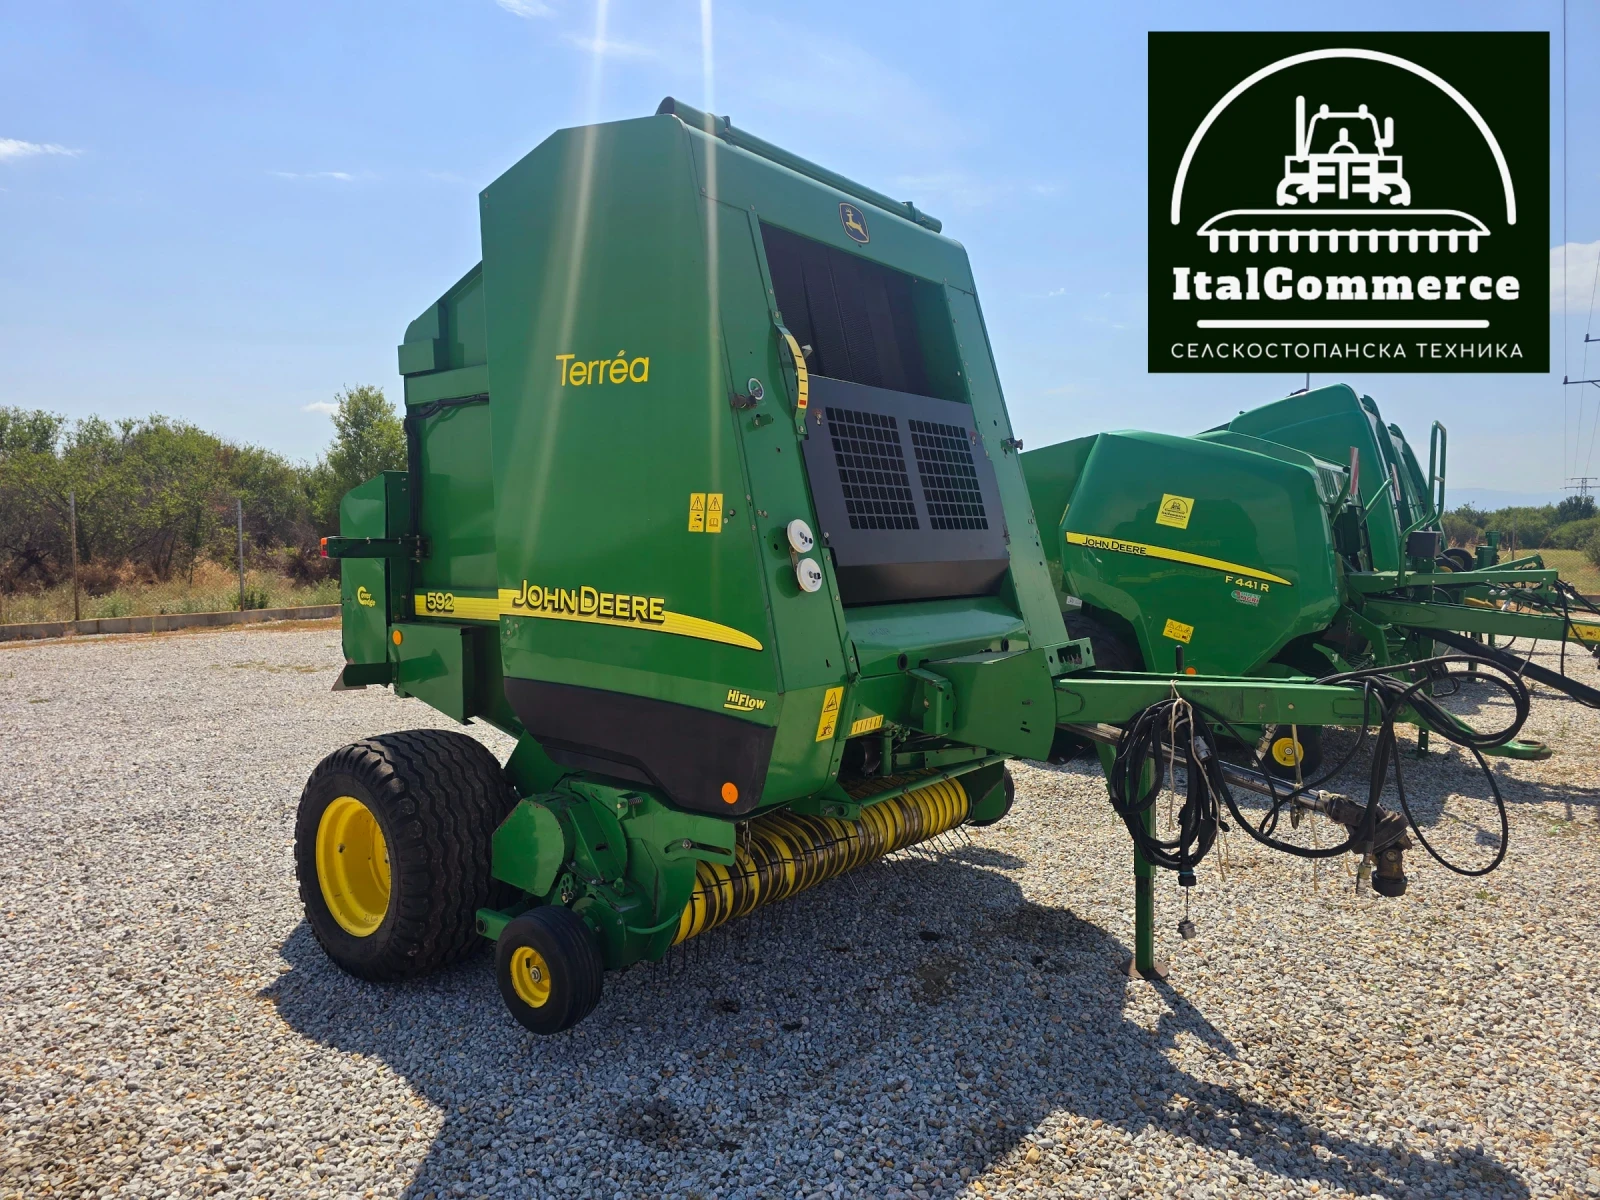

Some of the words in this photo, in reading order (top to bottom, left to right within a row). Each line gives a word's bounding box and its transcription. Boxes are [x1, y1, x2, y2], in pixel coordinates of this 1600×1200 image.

[555, 349, 650, 387] Terréa
[1082, 536, 1110, 549] JOHN
[1111, 540, 1147, 555] DEERE
[1224, 575, 1234, 584] F
[1235, 578, 1258, 590] 441
[1260, 583, 1270, 593] R
[426, 591, 455, 612] 592
[513, 579, 576, 613] JOHN
[579, 585, 665, 624] DEERE
[727, 689, 766, 710] HiFlow
